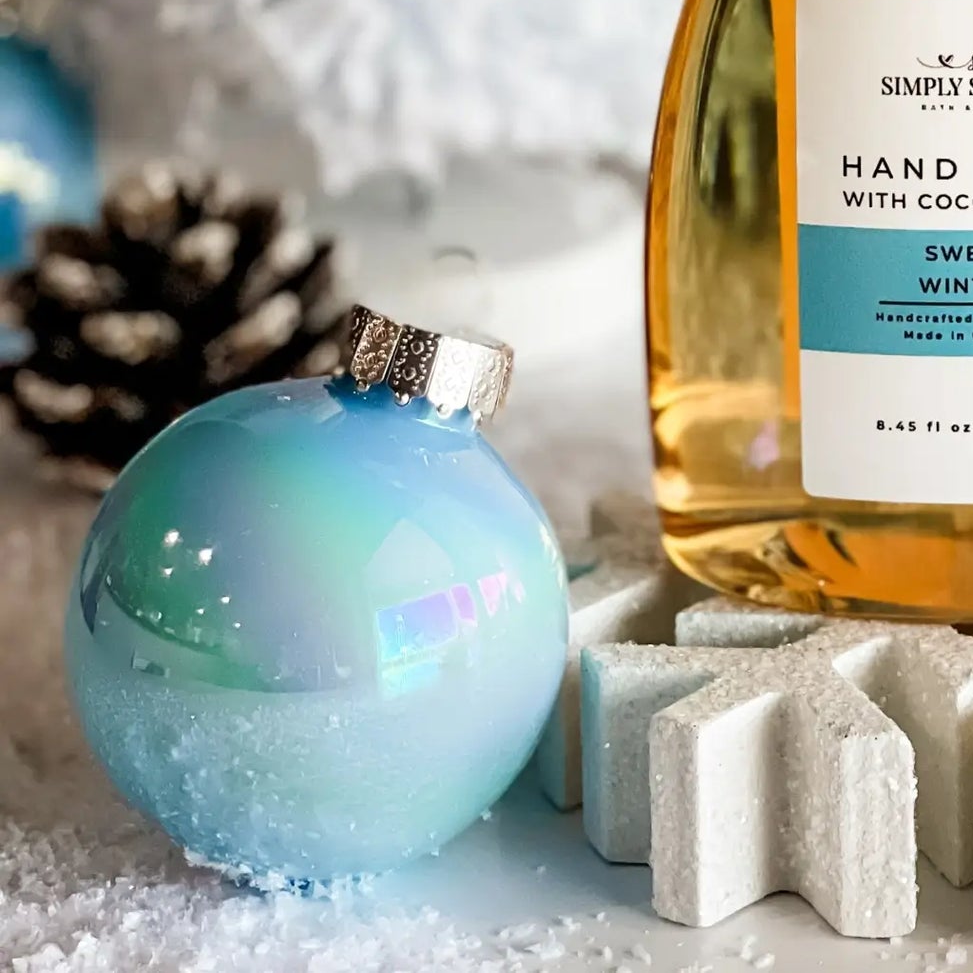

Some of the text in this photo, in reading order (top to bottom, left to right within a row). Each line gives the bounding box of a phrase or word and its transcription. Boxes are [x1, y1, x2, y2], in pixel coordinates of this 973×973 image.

[881, 76, 963, 97] SIMPLY
[842, 155, 958, 180] HAND
[842, 191, 907, 209] WITH
[875, 312, 973, 324] Handcrafted
[903, 330, 943, 341] Made
[951, 330, 965, 341] in
[876, 420, 917, 433] 8.45
[926, 421, 941, 433] fl
[950, 425, 971, 434] oz
